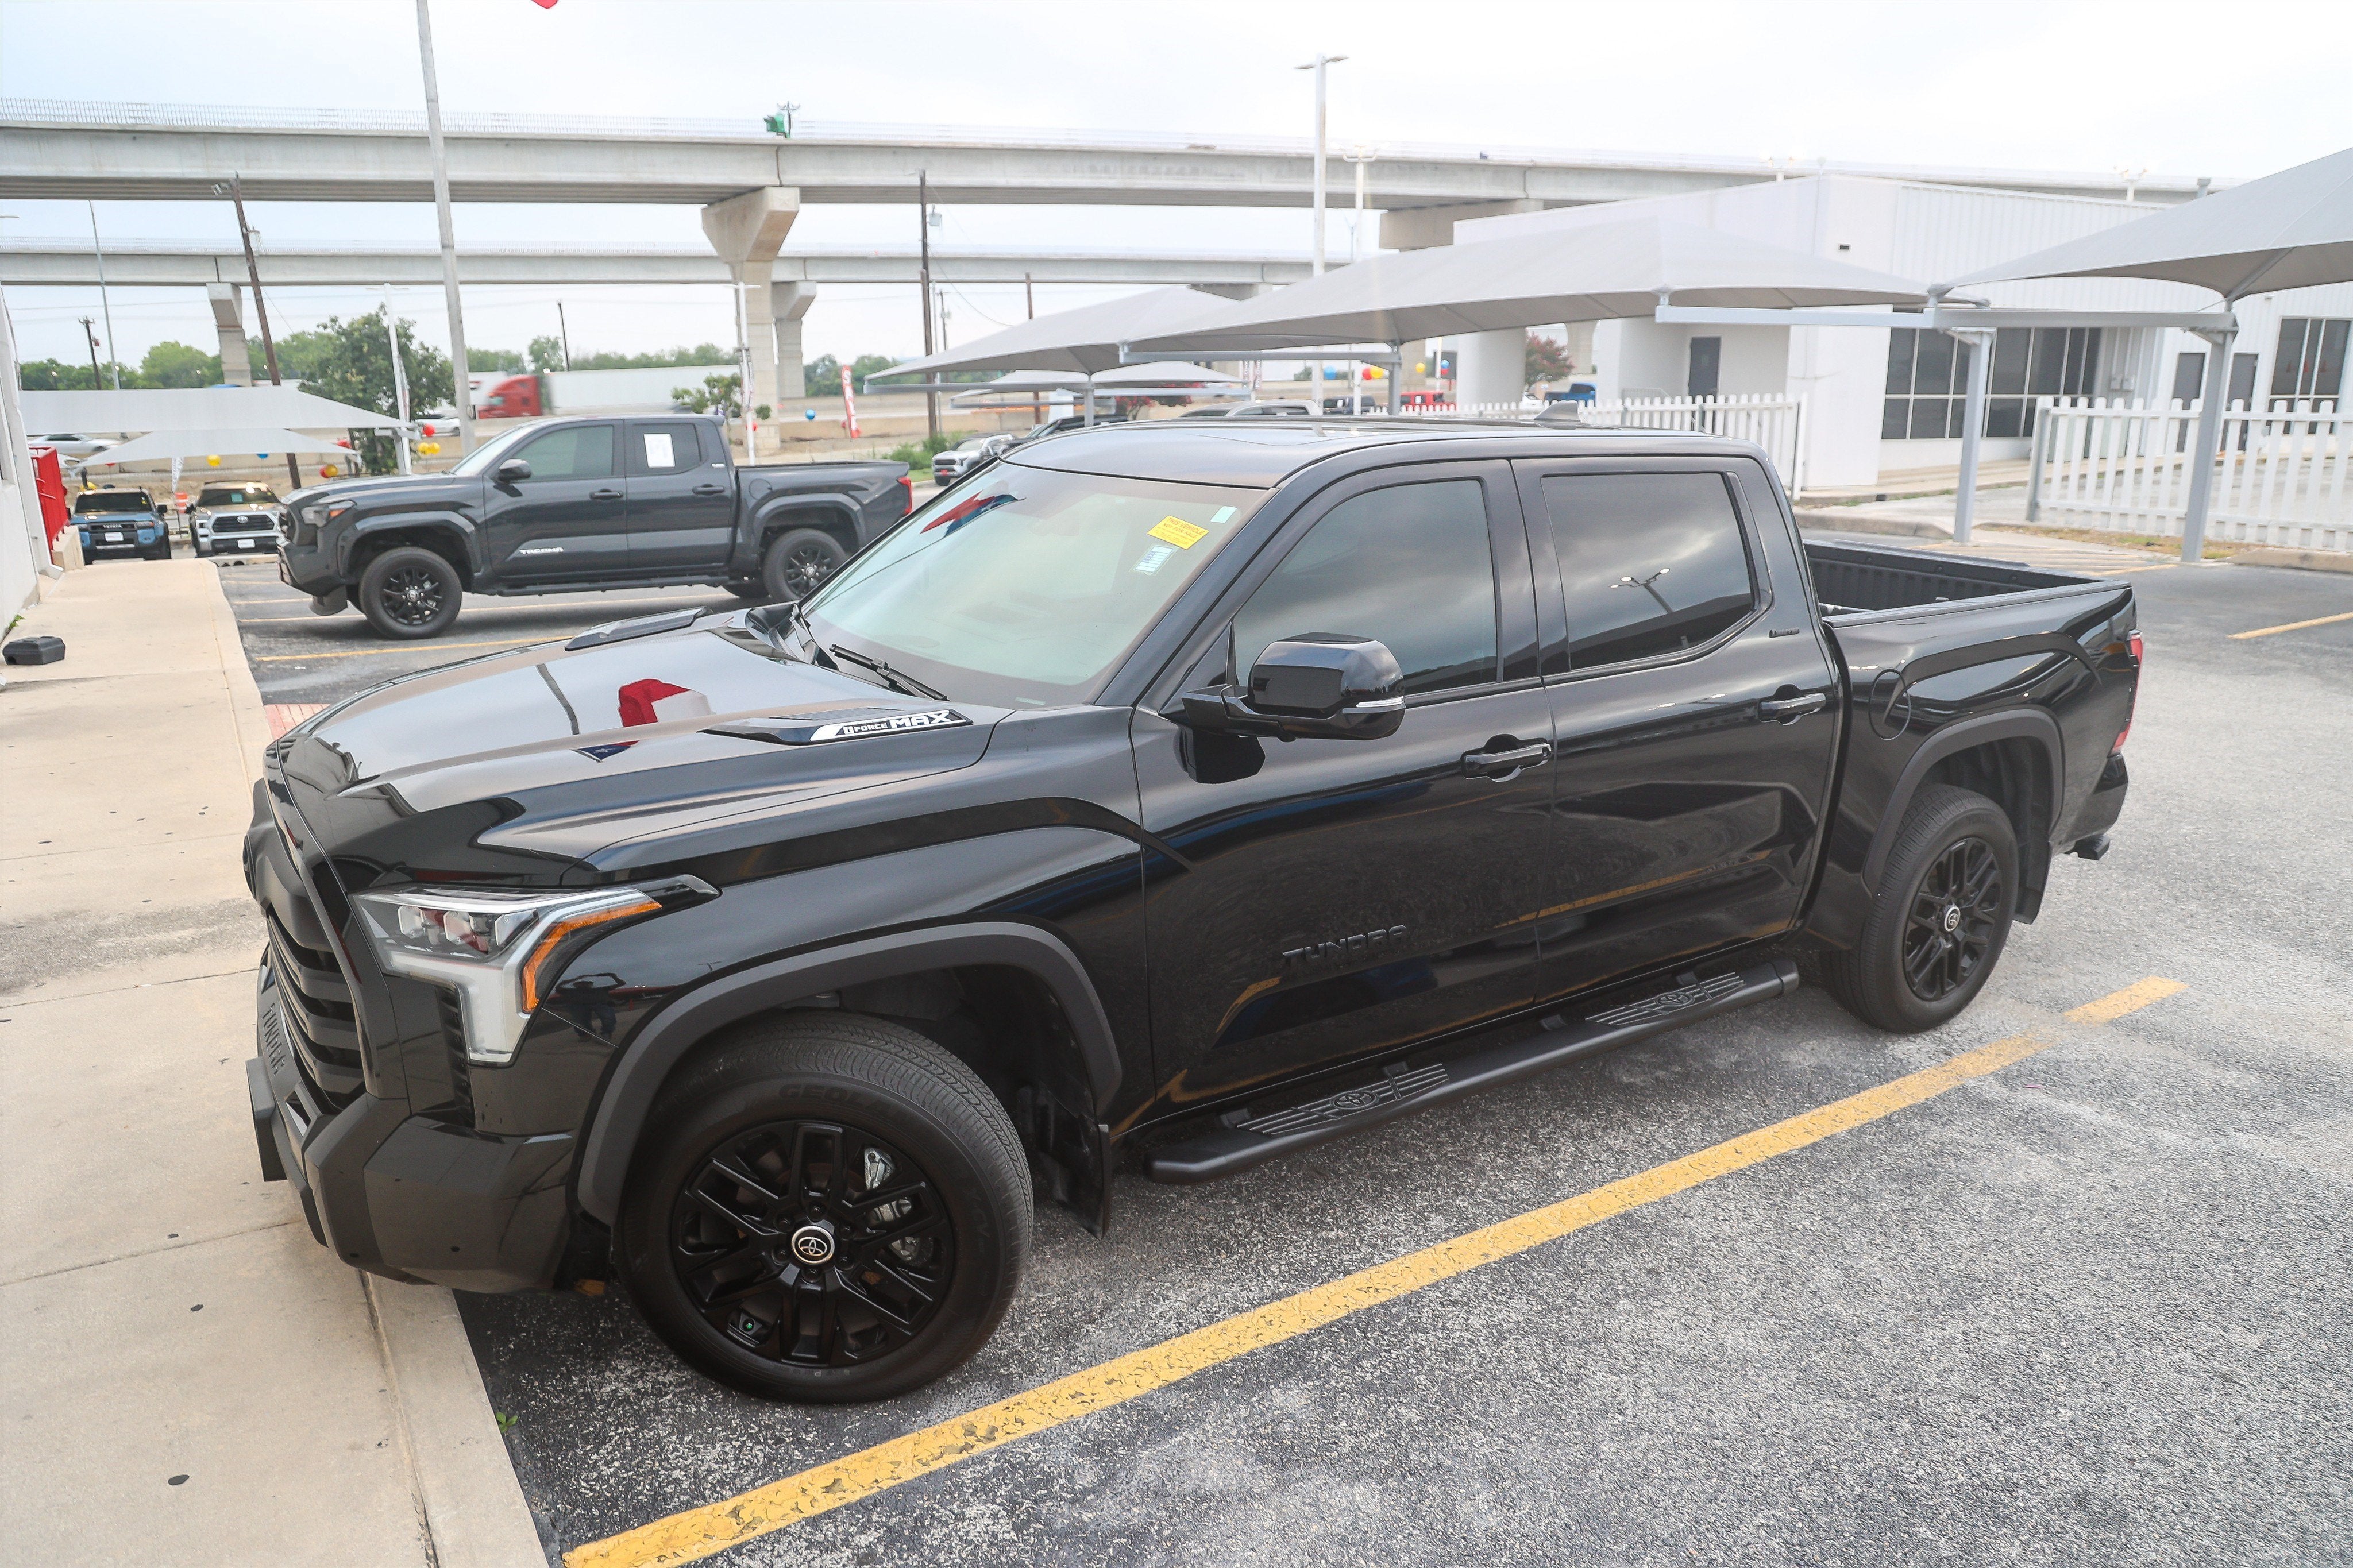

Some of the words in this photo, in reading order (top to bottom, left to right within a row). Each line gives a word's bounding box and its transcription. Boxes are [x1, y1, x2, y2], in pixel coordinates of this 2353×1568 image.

[1180, 523, 1205, 535] VEHICLE
[890, 712, 952, 728] MAX
[1282, 924, 1407, 965] TUNDRA
[261, 1002, 286, 1076] TUNDRA
